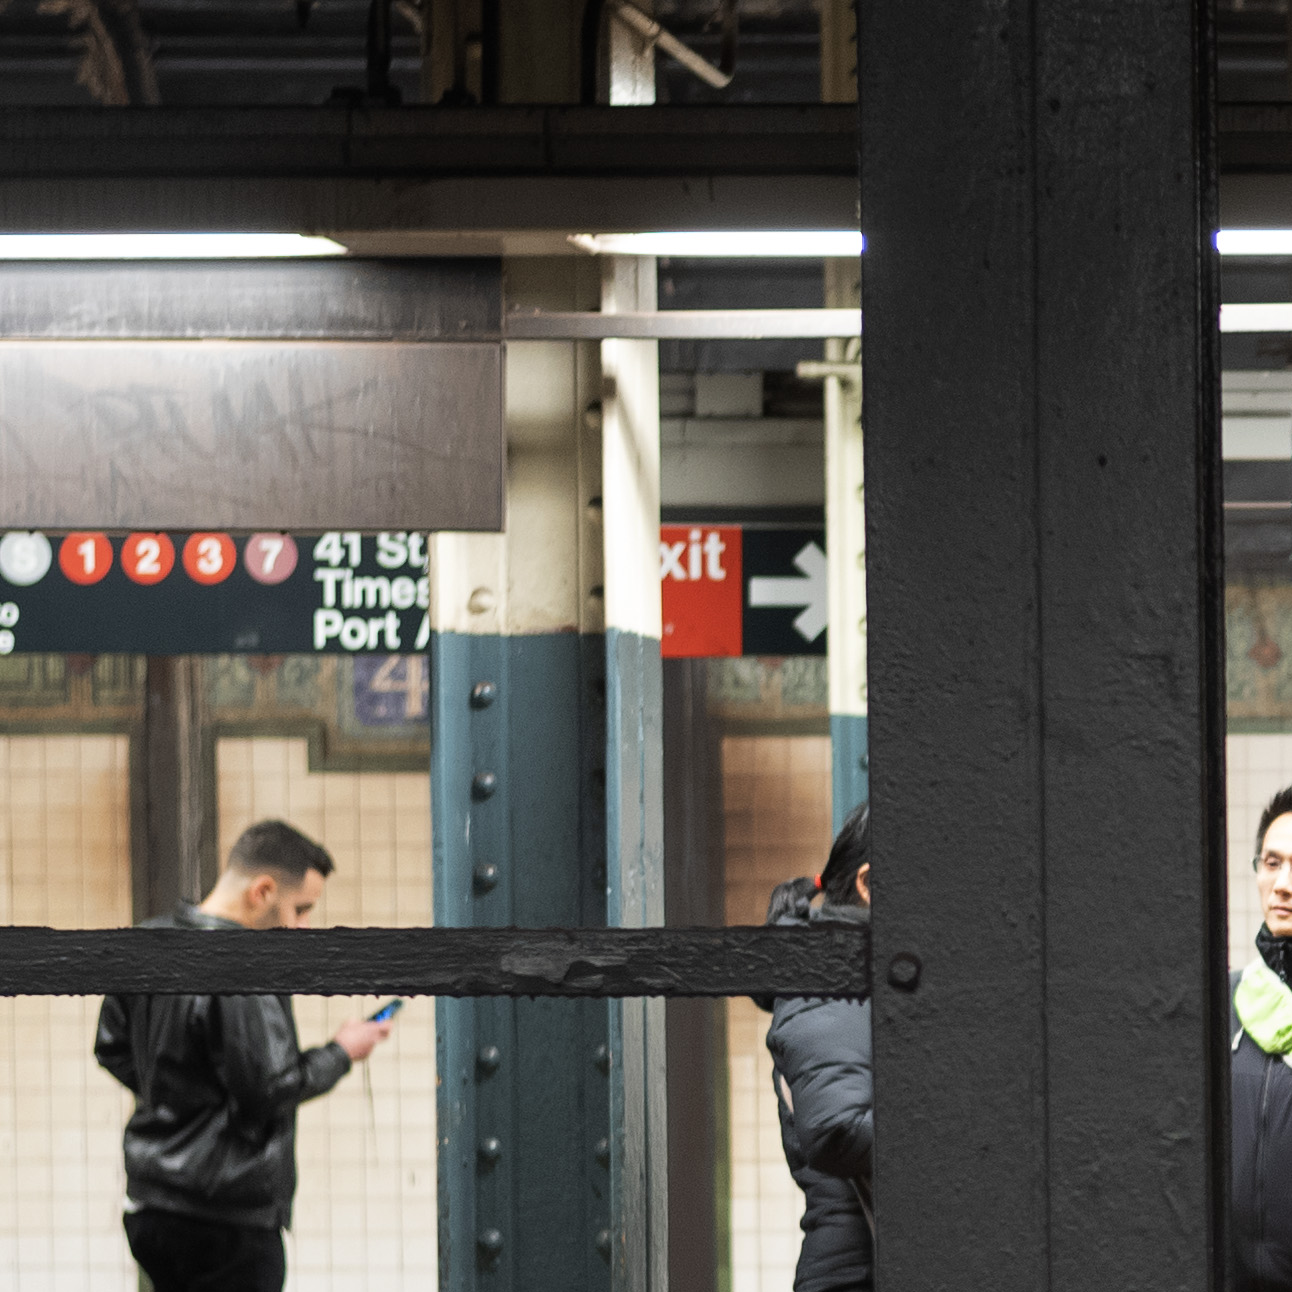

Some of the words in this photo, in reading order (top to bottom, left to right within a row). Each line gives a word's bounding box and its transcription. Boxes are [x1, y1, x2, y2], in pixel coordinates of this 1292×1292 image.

[77, 538, 97, 575] 1
[135, 538, 162, 575] 2
[197, 538, 224, 575] 3
[258, 538, 284, 575] 7
[314, 532, 363, 568] 41
[660, 529, 727, 581] xit
[314, 608, 402, 650] Port
[370, 655, 430, 718] 4
